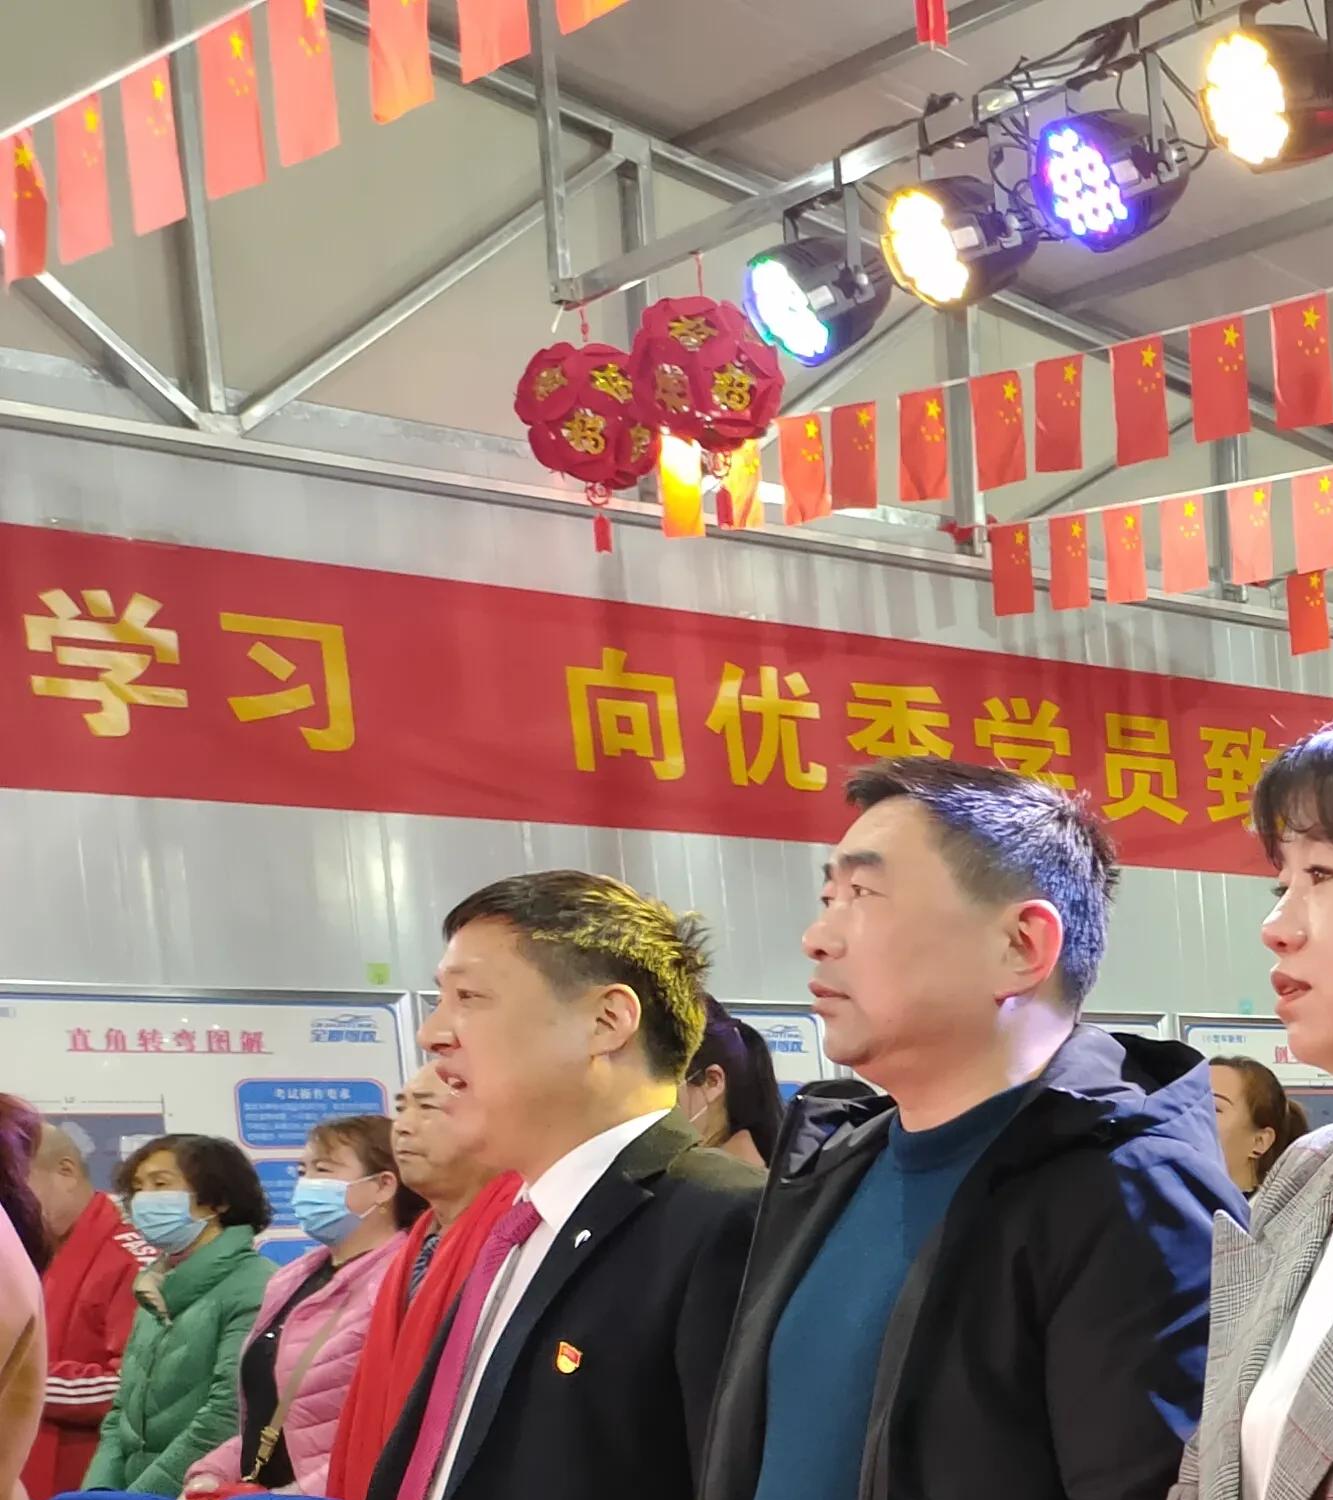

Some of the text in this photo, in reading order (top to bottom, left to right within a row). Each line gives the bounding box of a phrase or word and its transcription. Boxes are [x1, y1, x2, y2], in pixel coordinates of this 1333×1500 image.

[23, 588, 355, 753] 学习
[66, 1027, 268, 1053] 直角转弯图解
